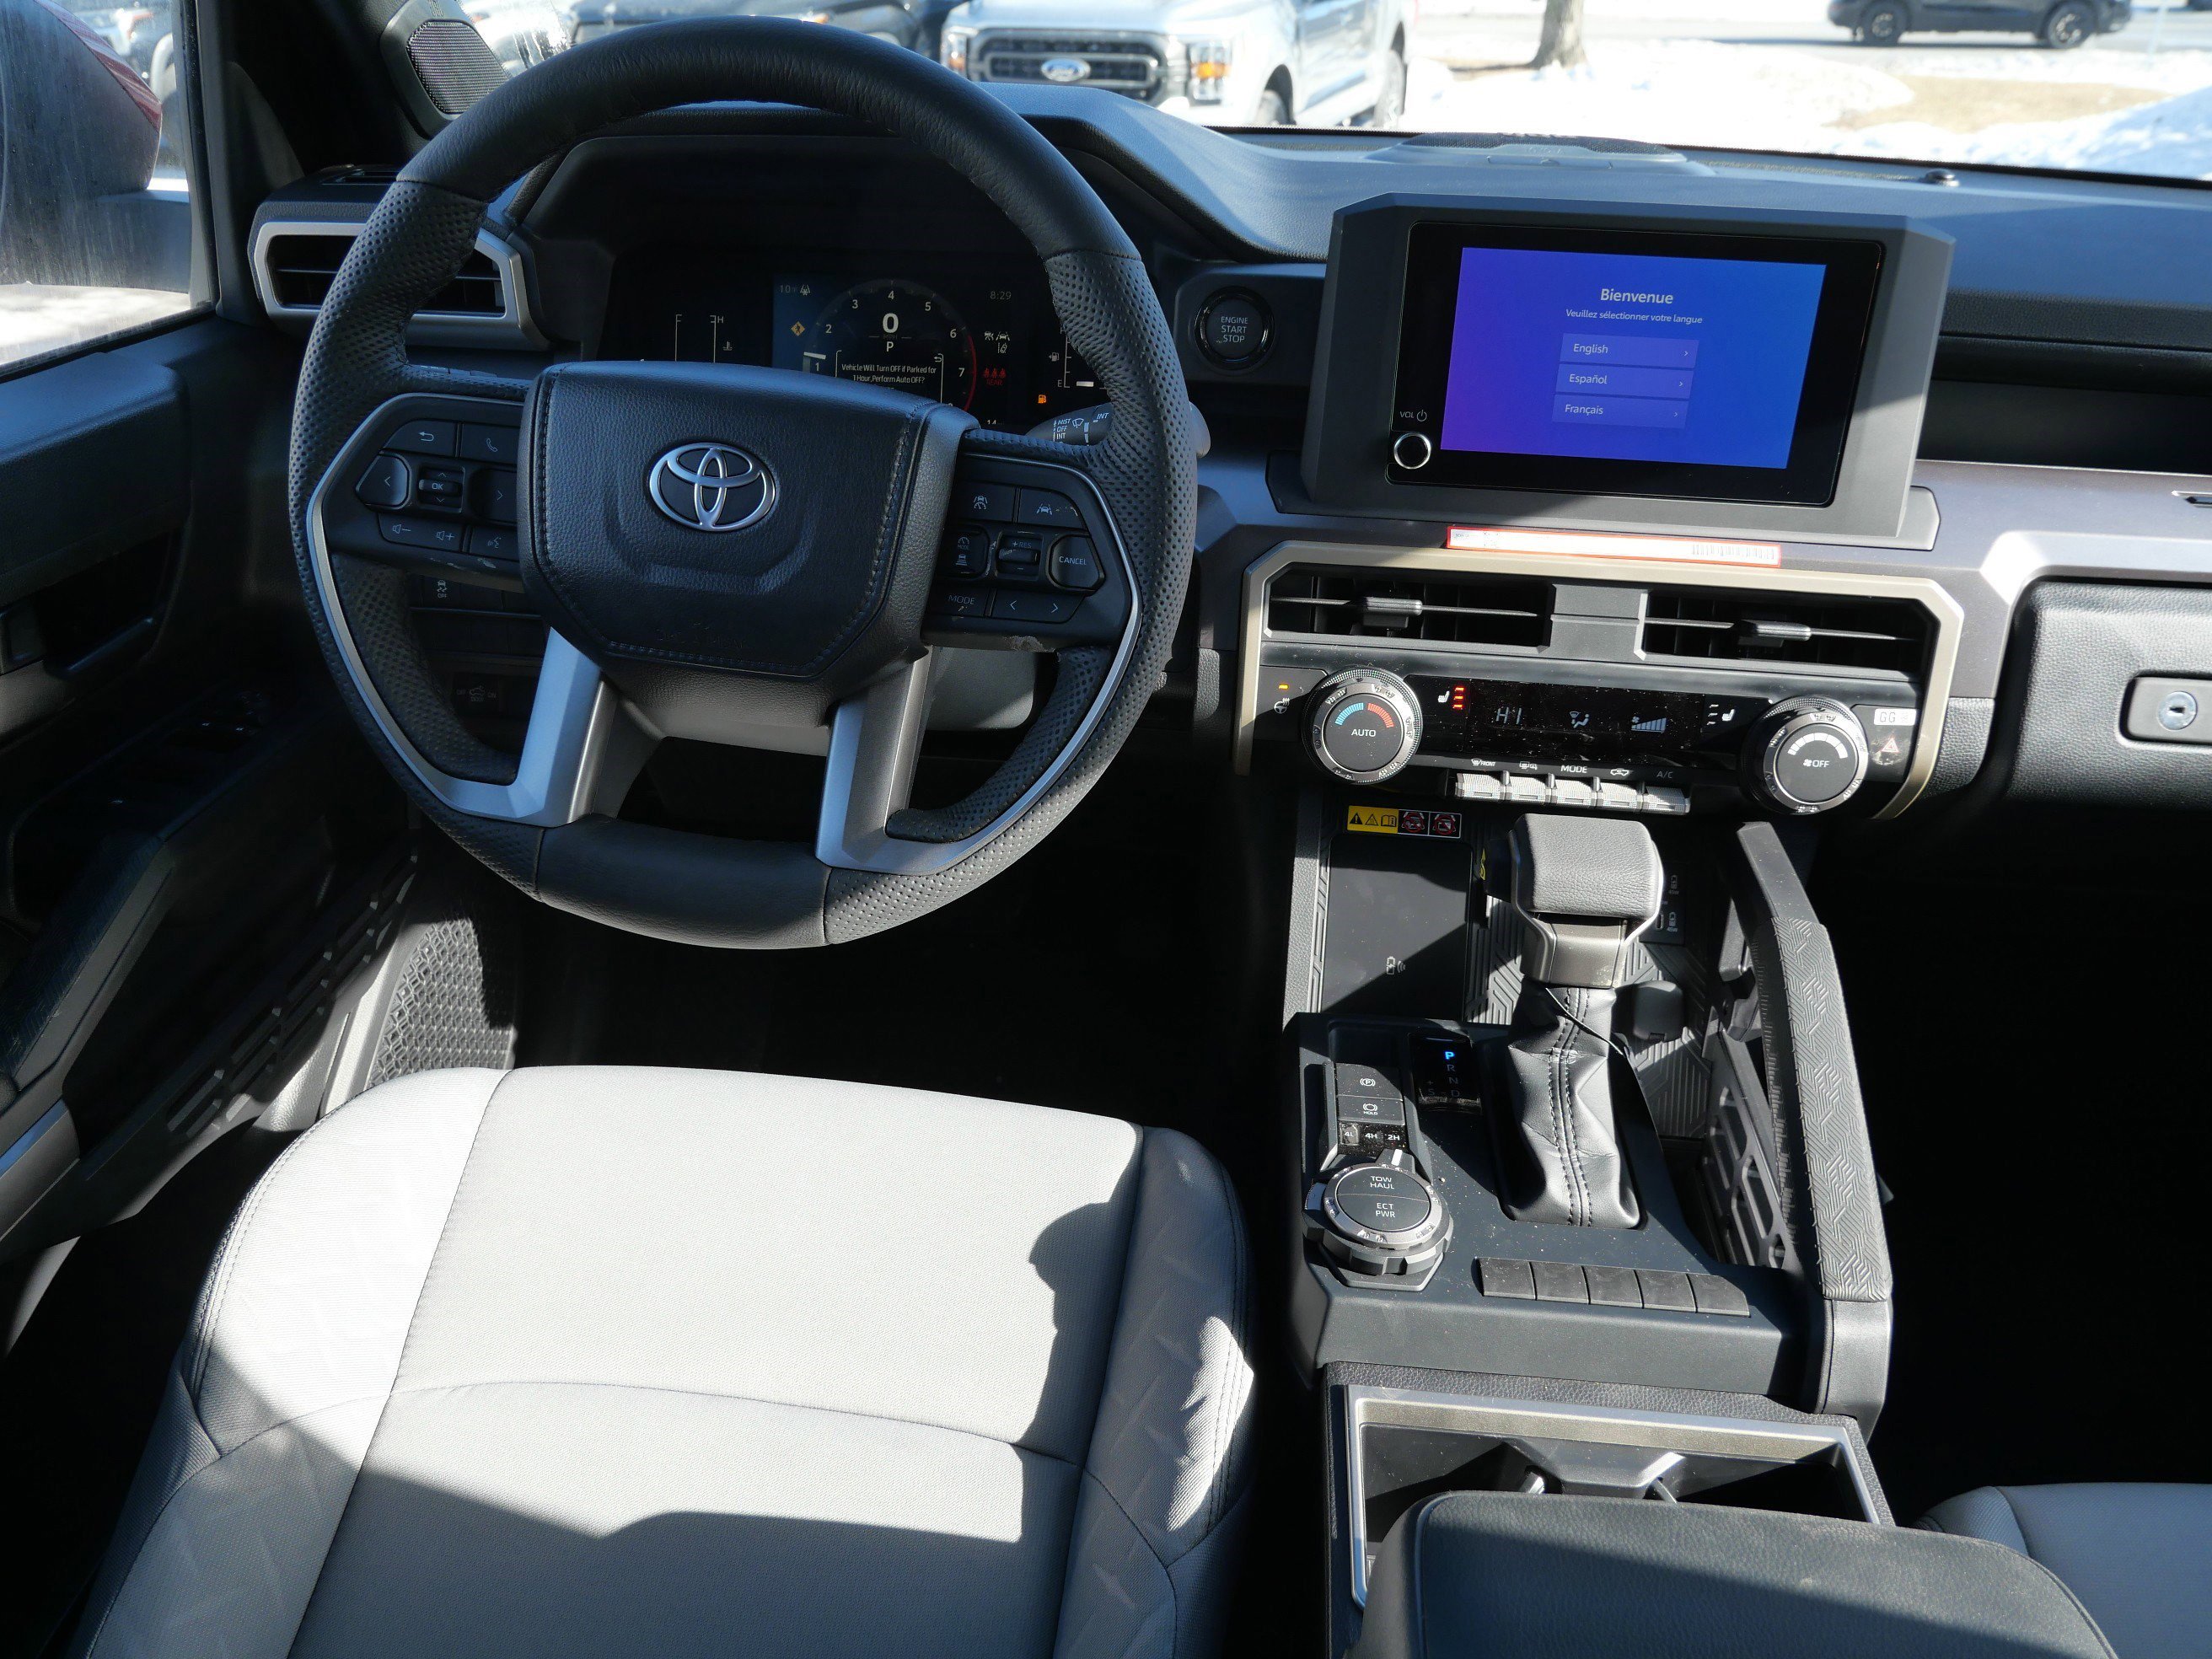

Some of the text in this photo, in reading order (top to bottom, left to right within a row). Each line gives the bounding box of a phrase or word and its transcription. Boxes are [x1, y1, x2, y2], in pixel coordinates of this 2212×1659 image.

[888, 290, 894, 300] 4
[990, 291, 1012, 300] 8:29
[1600, 288, 1674, 304] Bienvenue
[851, 299, 859, 309] 3
[924, 301, 932, 311] 5
[717, 315, 724, 324] H
[1221, 316, 1248, 325] ENGINE
[1565, 309, 1703, 325] Veuillez sélectionner votre langue
[882, 313, 899, 334] 0
[825, 324, 832, 334] 2
[949, 328, 958, 339] 6
[1221, 325, 1248, 334] START
[1222, 334, 1245, 343] STOP
[886, 341, 894, 352] P
[1573, 343, 1608, 355] English
[815, 362, 820, 372] 1
[841, 363, 863, 372] Vehicle
[863, 364, 875, 373] Will
[876, 364, 889, 373] Turn
[890, 365, 901, 373] OFF
[927, 366, 937, 374] for
[958, 368, 965, 377] 7
[910, 376, 926, 384] OFF?
[1057, 379, 1062, 388] E
[1569, 373, 1608, 385] Español
[1399, 411, 1415, 419] VOL
[1565, 404, 1604, 416] Français
[432, 482, 444, 491] OK
[1058, 556, 1087, 566] CANCEL
[948, 594, 975, 605] MODE
[1350, 728, 1377, 738] AUTO
[1560, 765, 1588, 774] MODE
[1812, 760, 1830, 769] OFF
[1656, 770, 1673, 780] A/C
[1444, 1050, 1456, 1060] P
[1446, 1064, 1457, 1072] R
[1448, 1076, 1458, 1085] N
[1450, 1089, 1460, 1098] D
[1375, 1210, 1396, 1218] PWR
